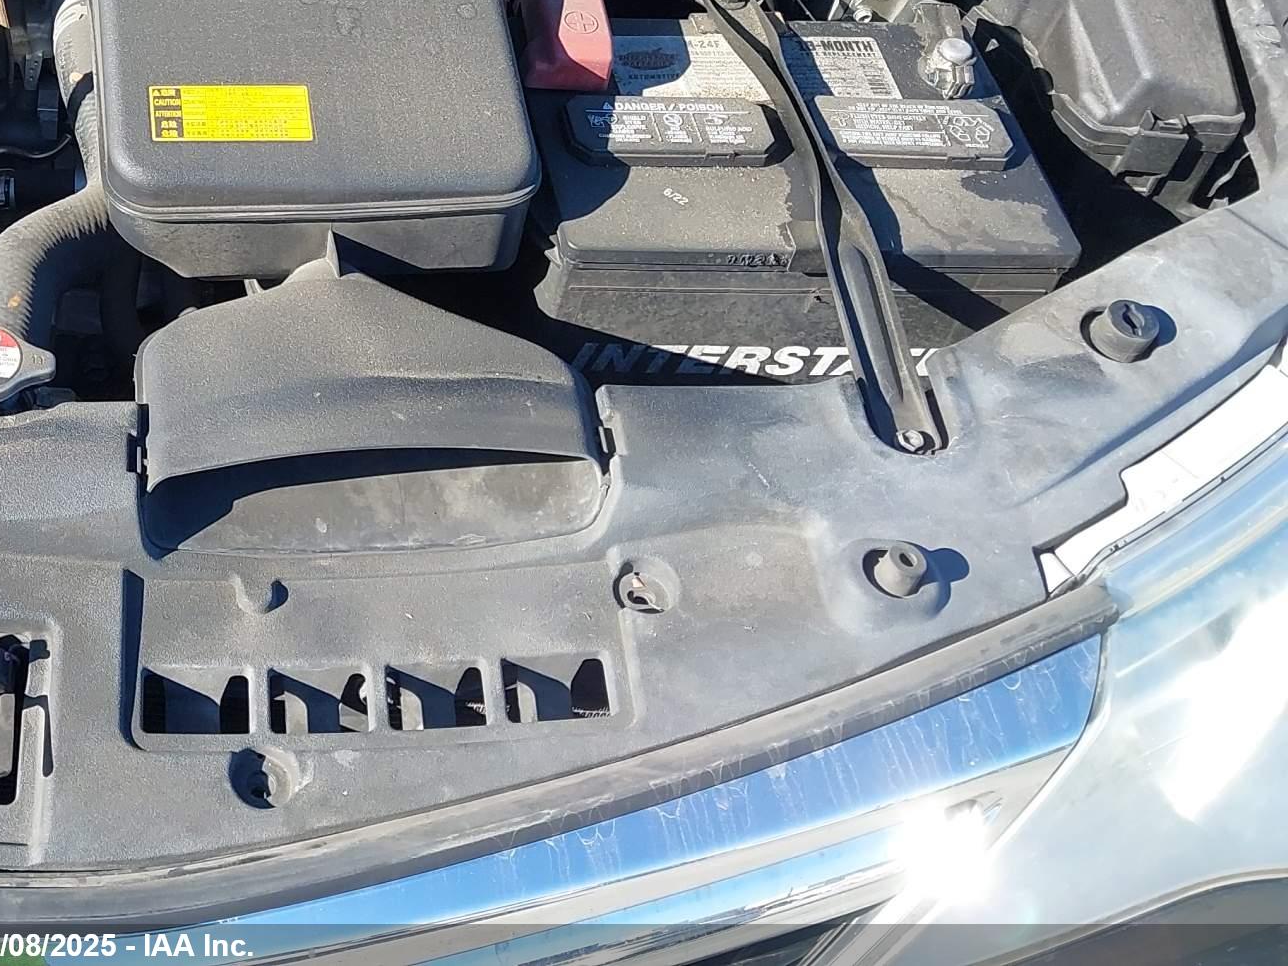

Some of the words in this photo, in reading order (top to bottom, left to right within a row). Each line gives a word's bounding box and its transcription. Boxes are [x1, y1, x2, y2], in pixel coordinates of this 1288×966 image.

[614, 102, 666, 111] DANGER
[678, 103, 725, 112] POISON
[663, 188, 689, 205] 6/22
